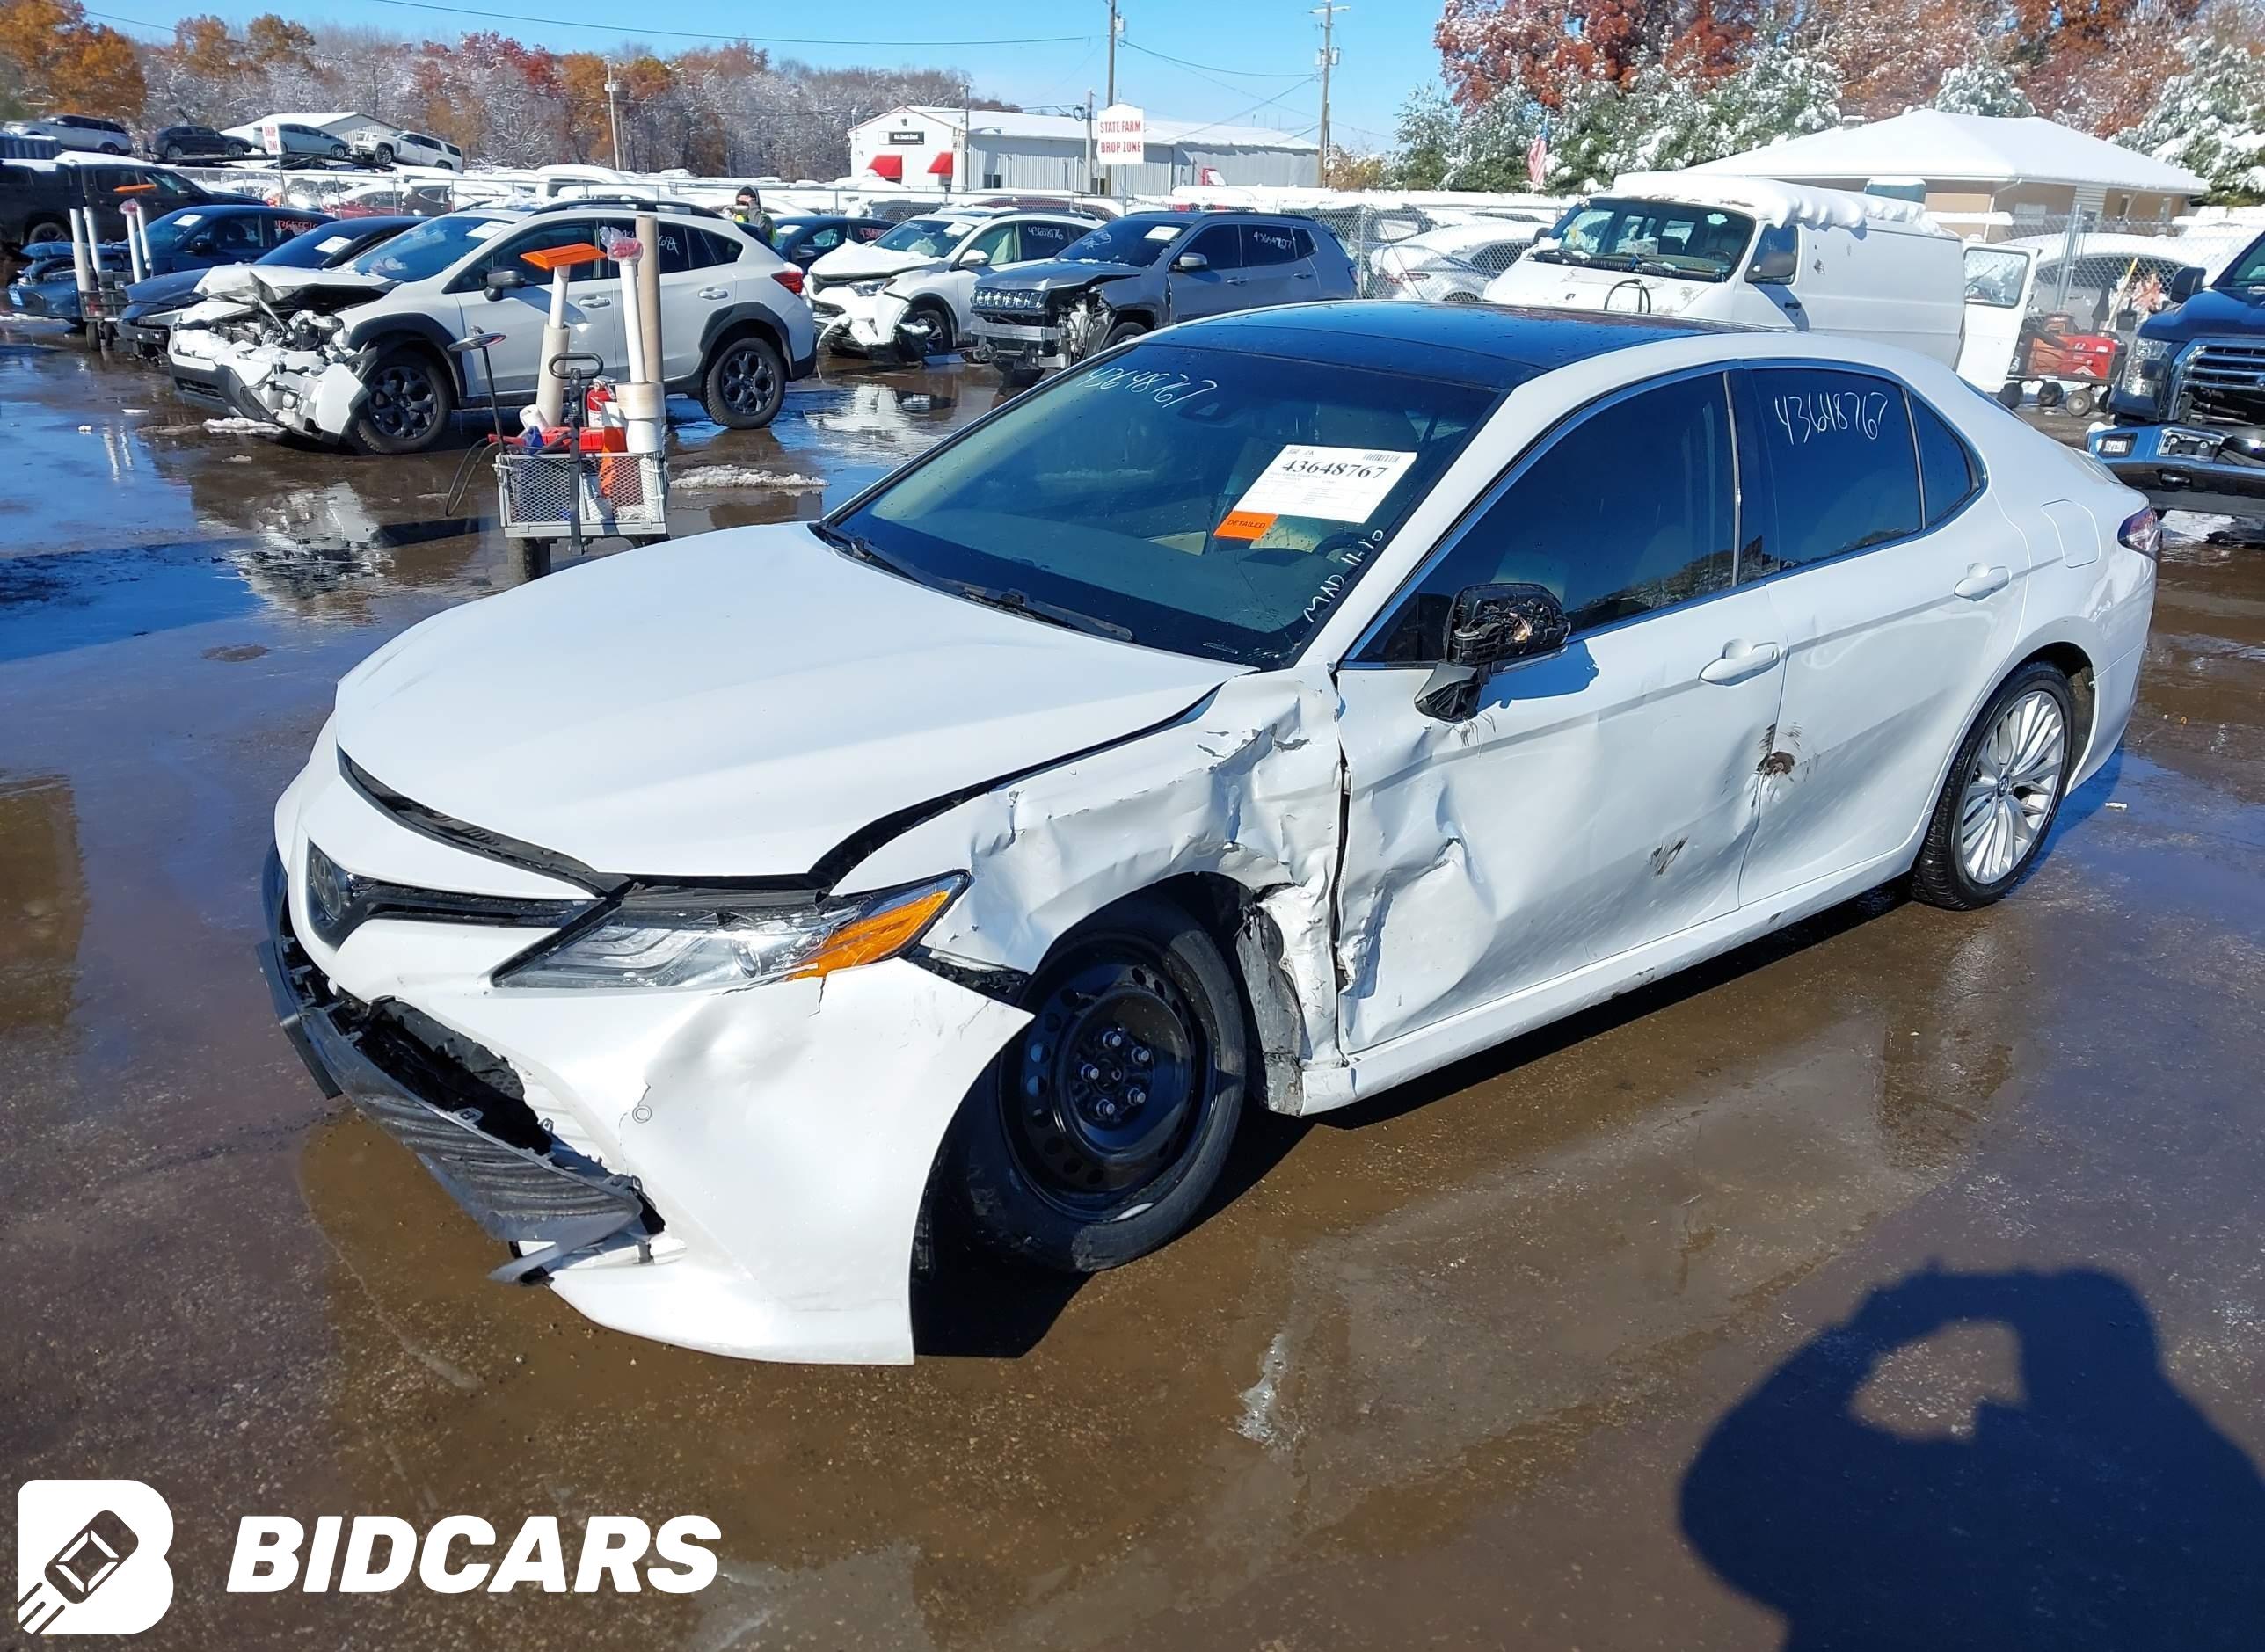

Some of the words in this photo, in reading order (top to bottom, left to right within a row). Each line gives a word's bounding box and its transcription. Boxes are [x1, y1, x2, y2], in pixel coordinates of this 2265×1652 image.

[1100, 121, 1119, 133] STATE
[1121, 120, 1141, 132] FARM
[1100, 142, 1121, 153] DROP
[1122, 141, 1141, 153] ZONE
[1076, 367, 1218, 409] 43648767
[1774, 391, 1889, 446] 43648767
[1280, 459, 1389, 479] 43648767
[1227, 519, 1267, 529] DETAILED
[1303, 574, 1344, 622] MAD
